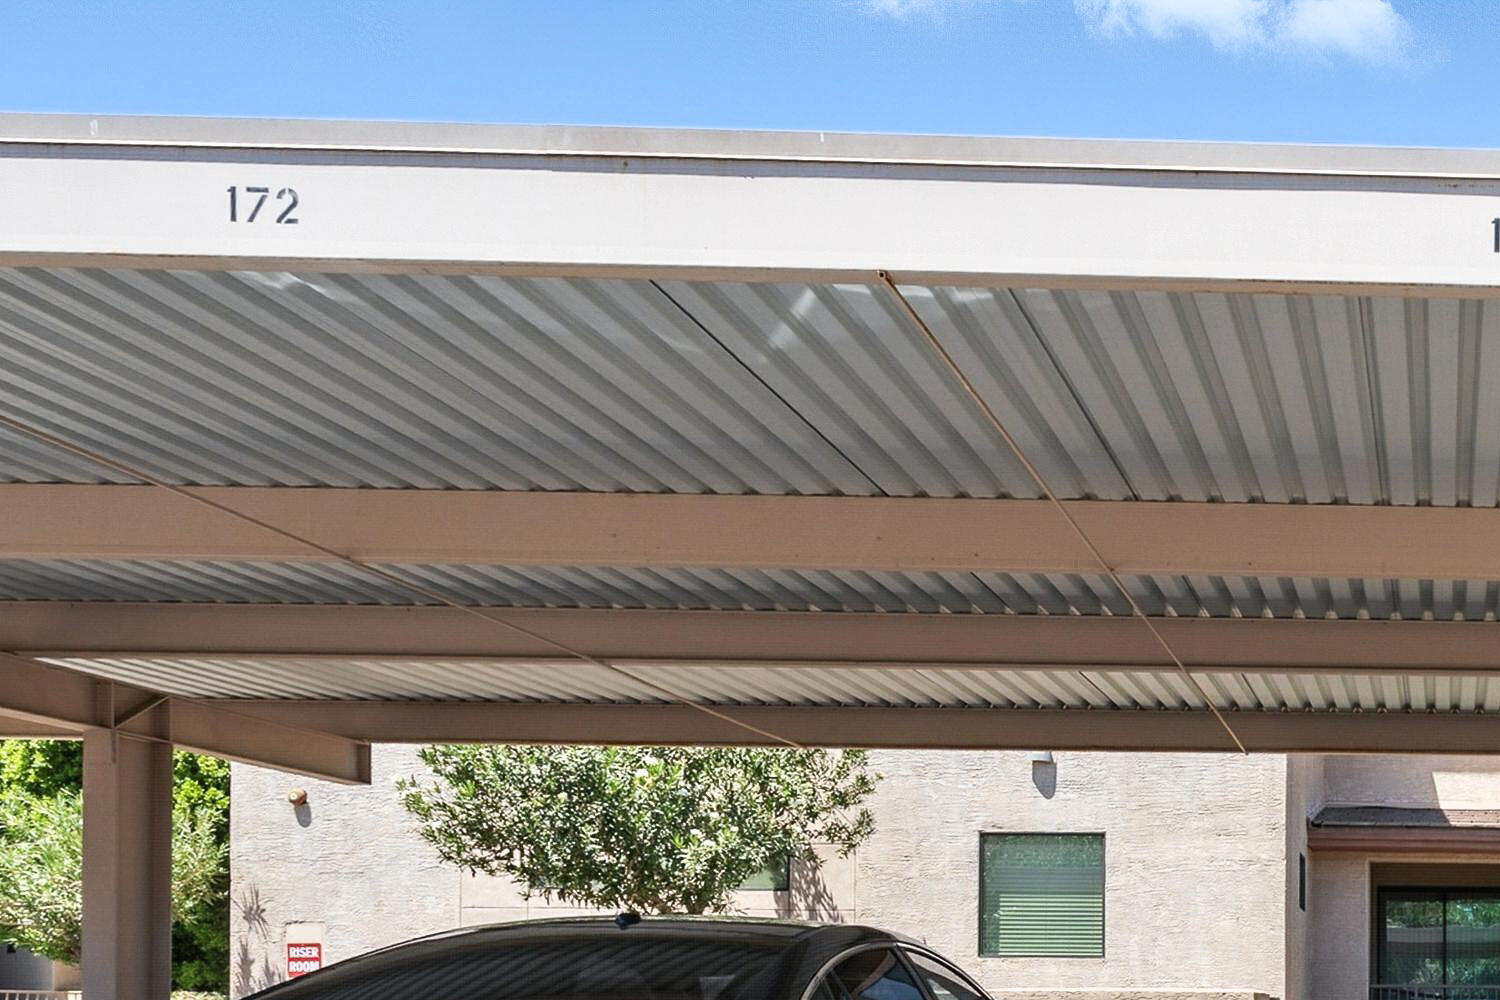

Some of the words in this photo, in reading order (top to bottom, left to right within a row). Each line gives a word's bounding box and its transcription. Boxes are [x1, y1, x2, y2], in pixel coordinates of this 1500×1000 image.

[226, 186, 299, 224] 172
[289, 946, 319, 958] RISER
[289, 960, 320, 973] ROOM
